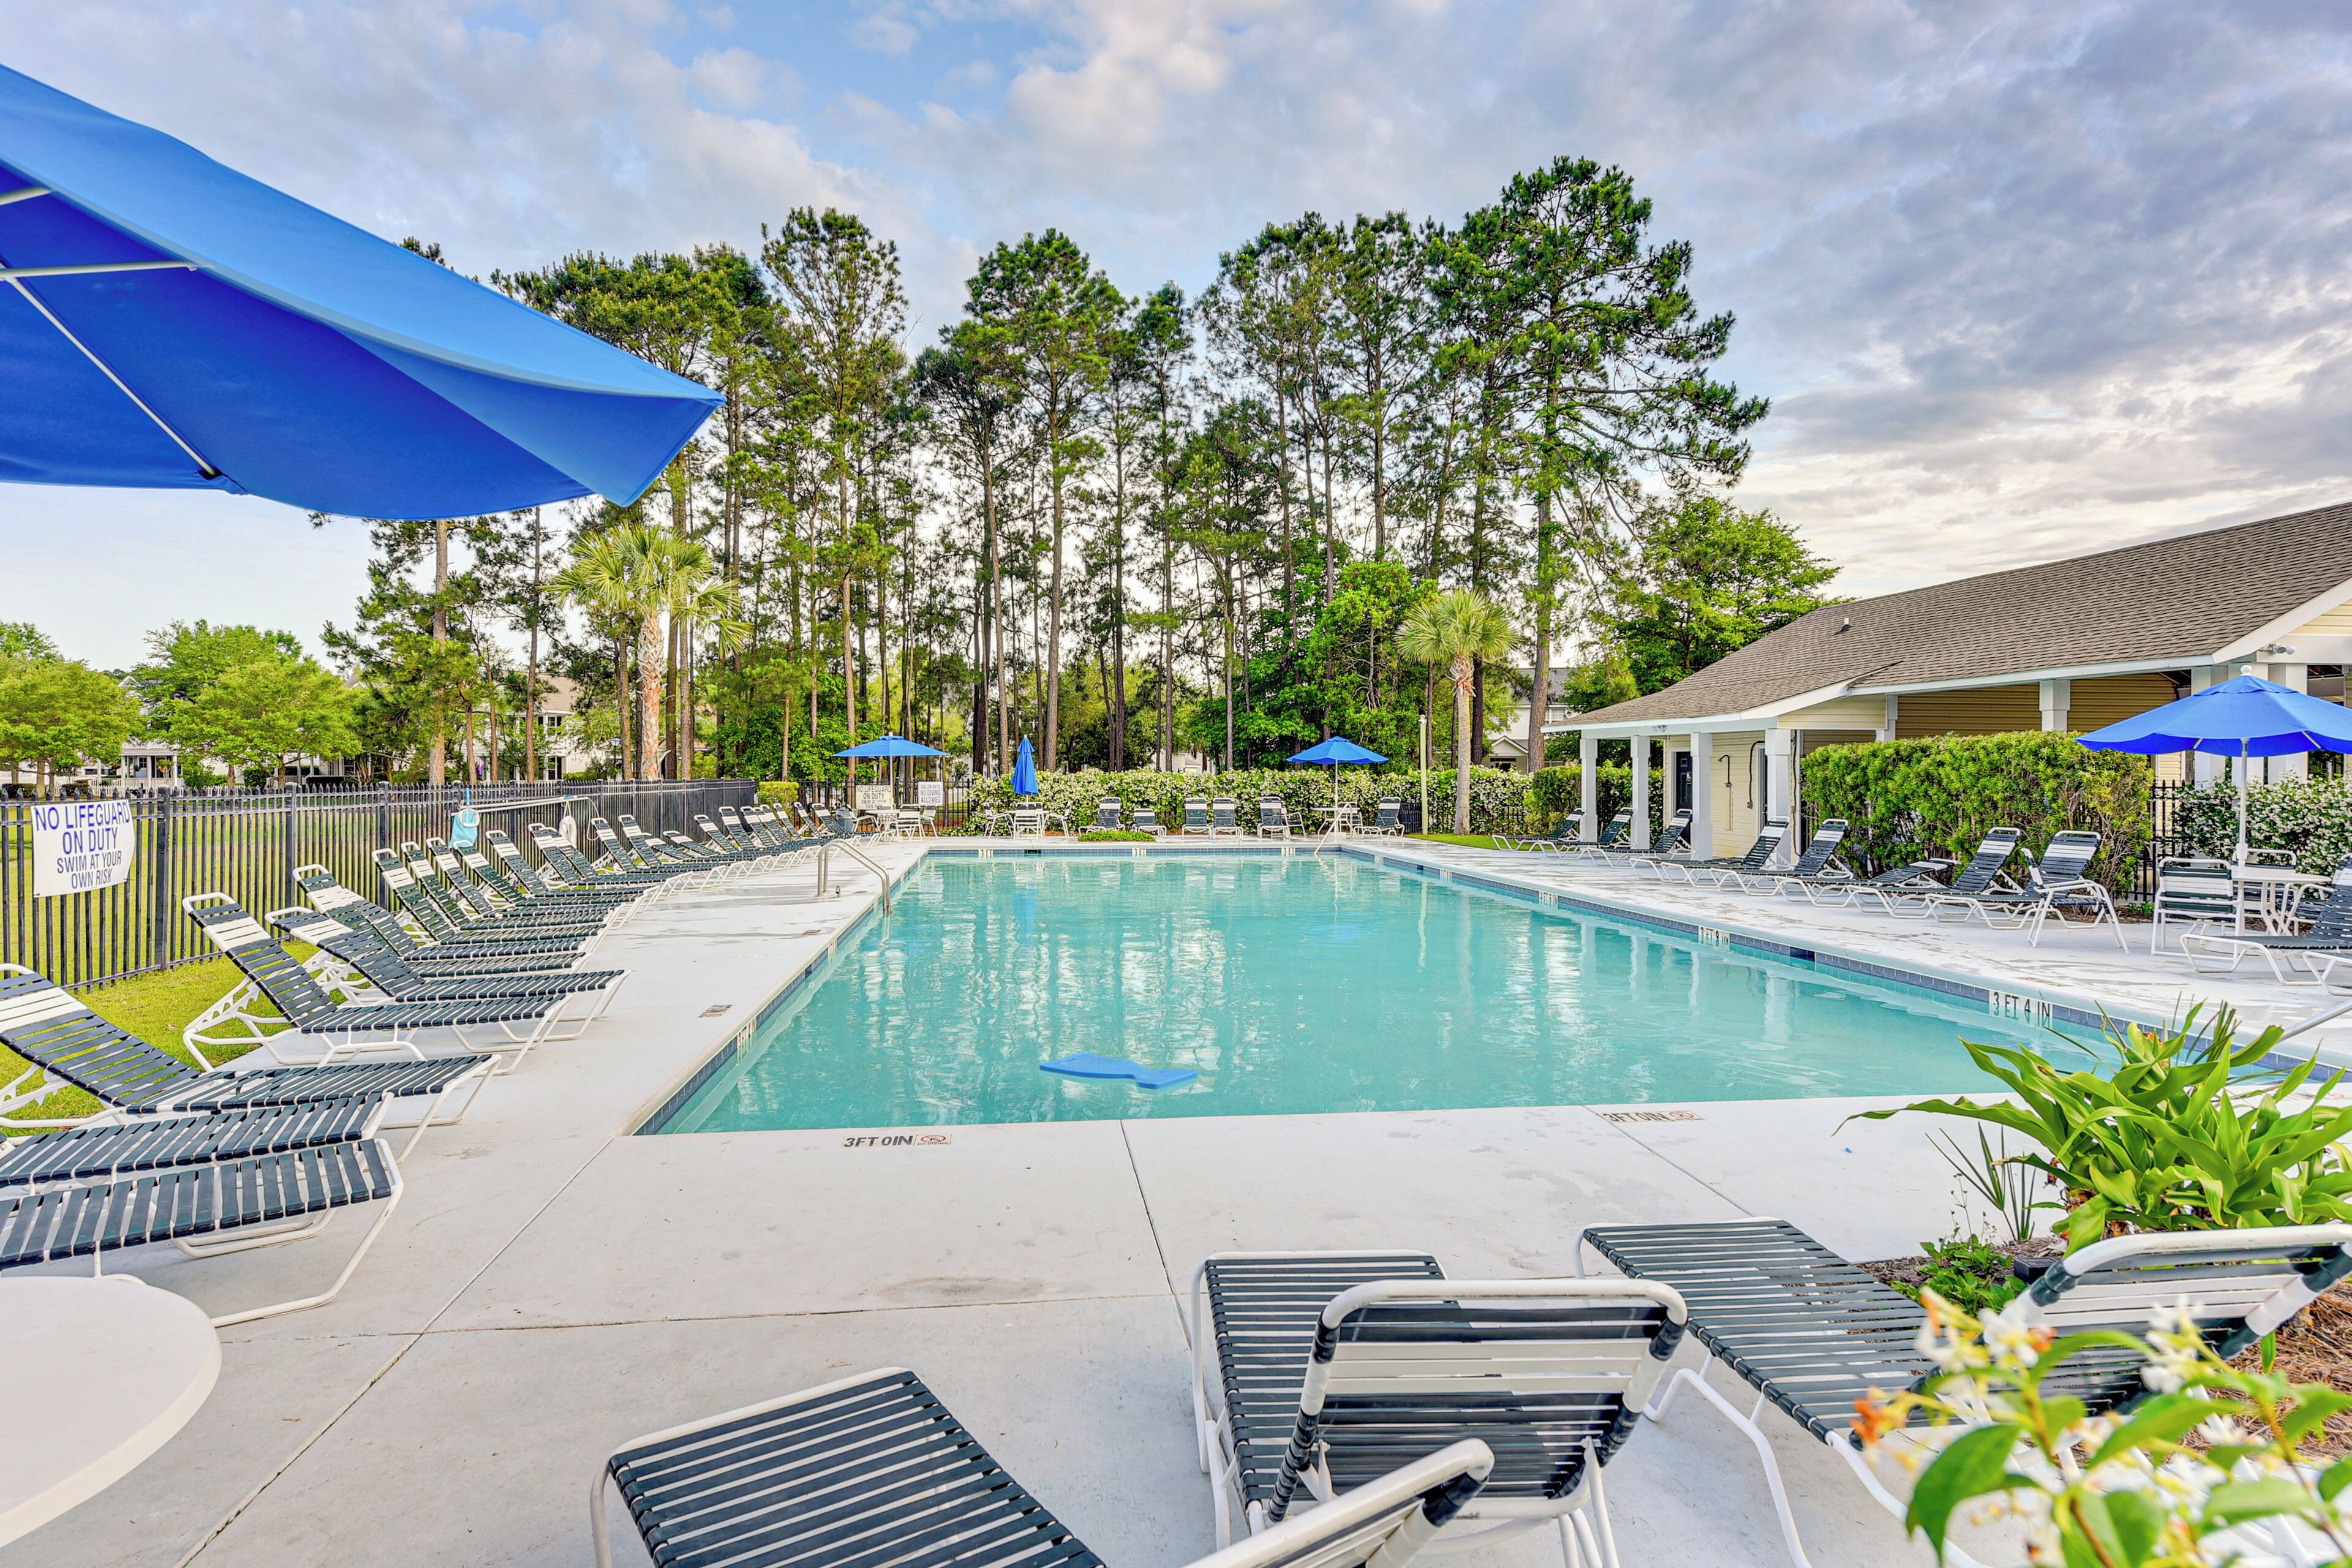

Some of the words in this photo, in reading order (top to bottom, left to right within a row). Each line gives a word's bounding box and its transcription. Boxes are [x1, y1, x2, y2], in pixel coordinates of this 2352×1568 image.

[35, 807, 60, 831] NO
[65, 801, 130, 829] LIFEGUARD
[62, 830, 83, 854] ON
[88, 827, 118, 852] DUTY
[57, 854, 87, 873] SWIM
[90, 853, 100, 870] AT
[102, 850, 122, 868] YOUR
[71, 871, 93, 889] OWN
[96, 868, 113, 885] RISK
[2005, 994, 2019, 1010] FT
[2024, 998, 2031, 1012] 4
[2037, 1001, 2050, 1017] IN
[1602, 1112, 1637, 1121] 3FT
[843, 1136, 879, 1147] 3FT
